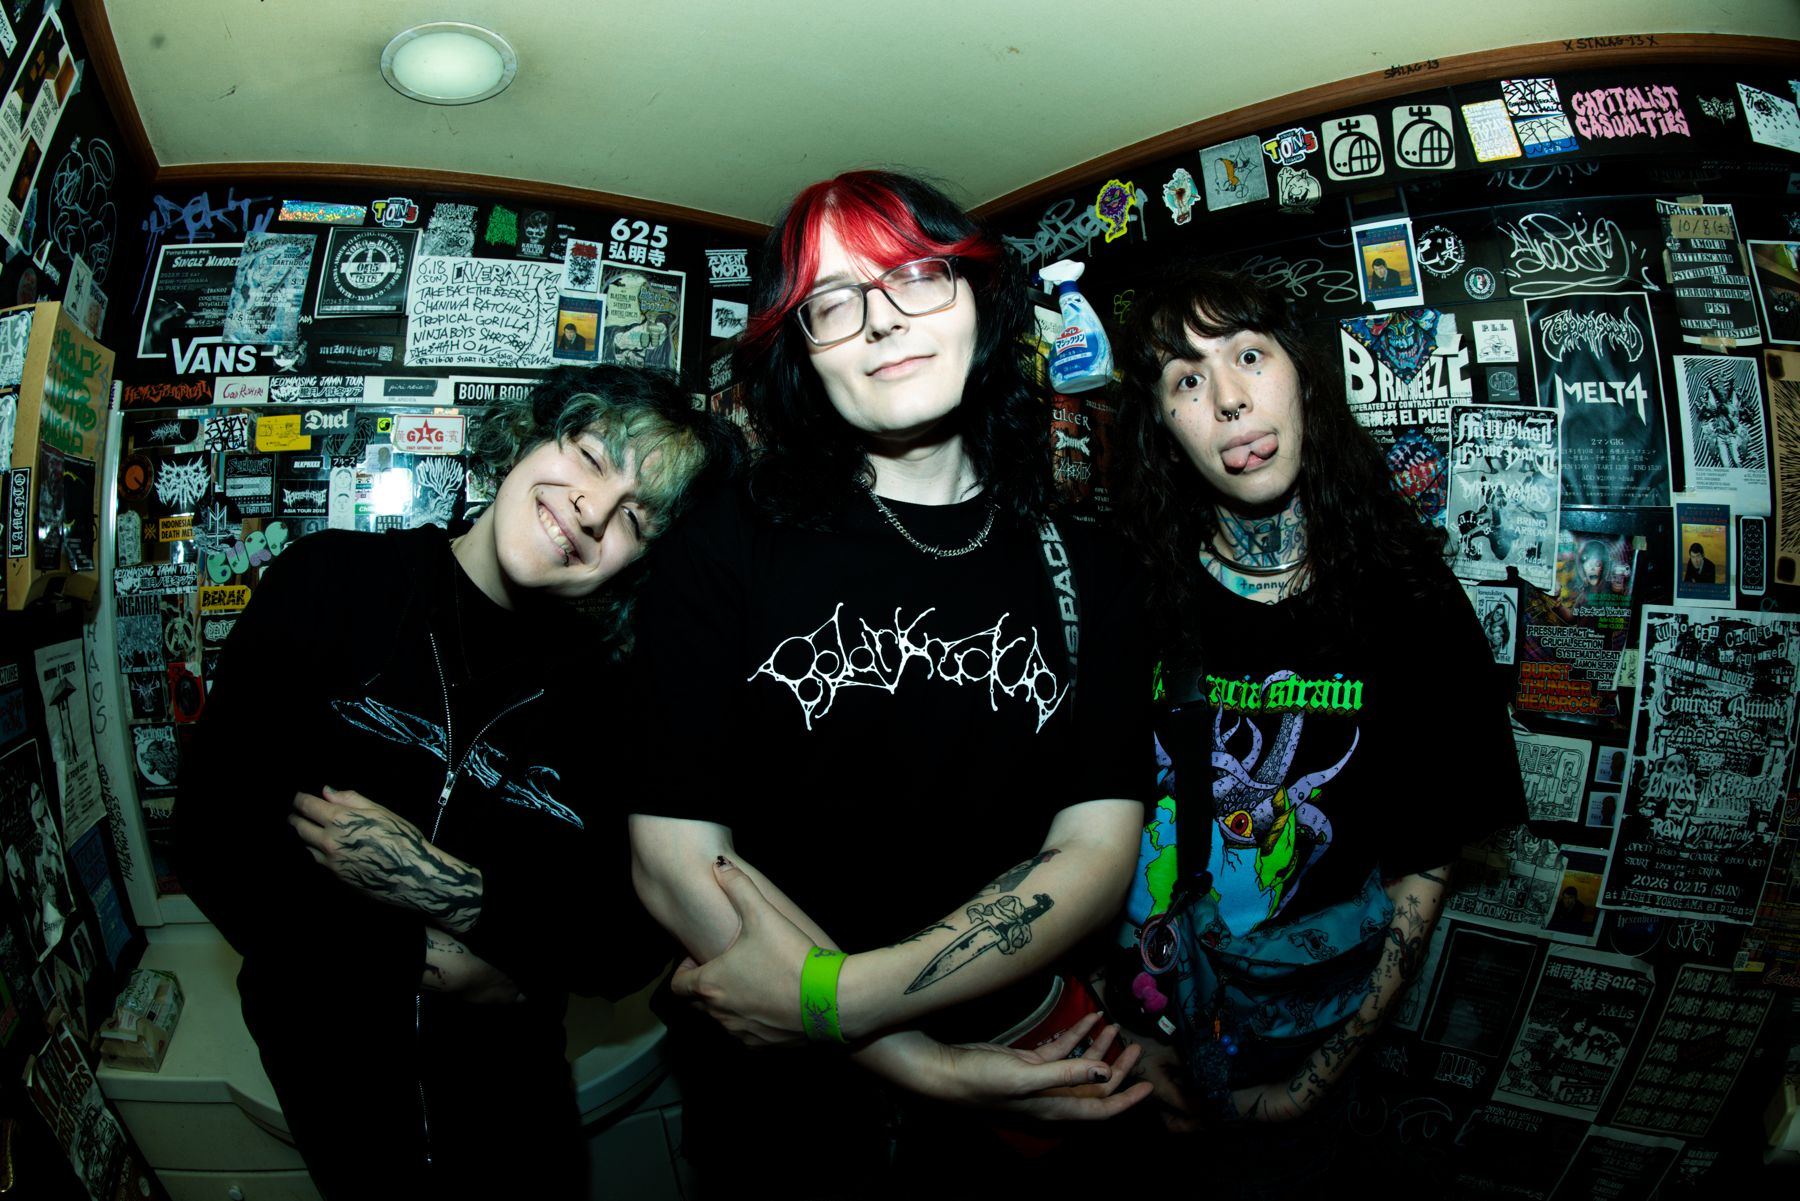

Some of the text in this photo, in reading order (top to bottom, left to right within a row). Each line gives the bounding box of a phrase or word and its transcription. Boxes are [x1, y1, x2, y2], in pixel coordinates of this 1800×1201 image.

[610, 218, 668, 249] 625
[608, 241, 667, 267] 弘明寺
[418, 258, 447, 275] 6.18
[412, 313, 530, 332] TROPICAL GORILLA
[172, 338, 257, 374] VANS
[459, 384, 494, 401] BOOM
[1387, 401, 1397, 410] BY
[1399, 400, 1436, 409] CONTRAST
[1401, 409, 1418, 425] EL
[161, 528, 195, 540] DEATH MET
[1527, 625, 1588, 638] PRESSURE PACT
[1572, 638, 1604, 649] SECTION
[1651, 651, 1756, 689] YOKOHAMA BRAIN SQUEEZE
